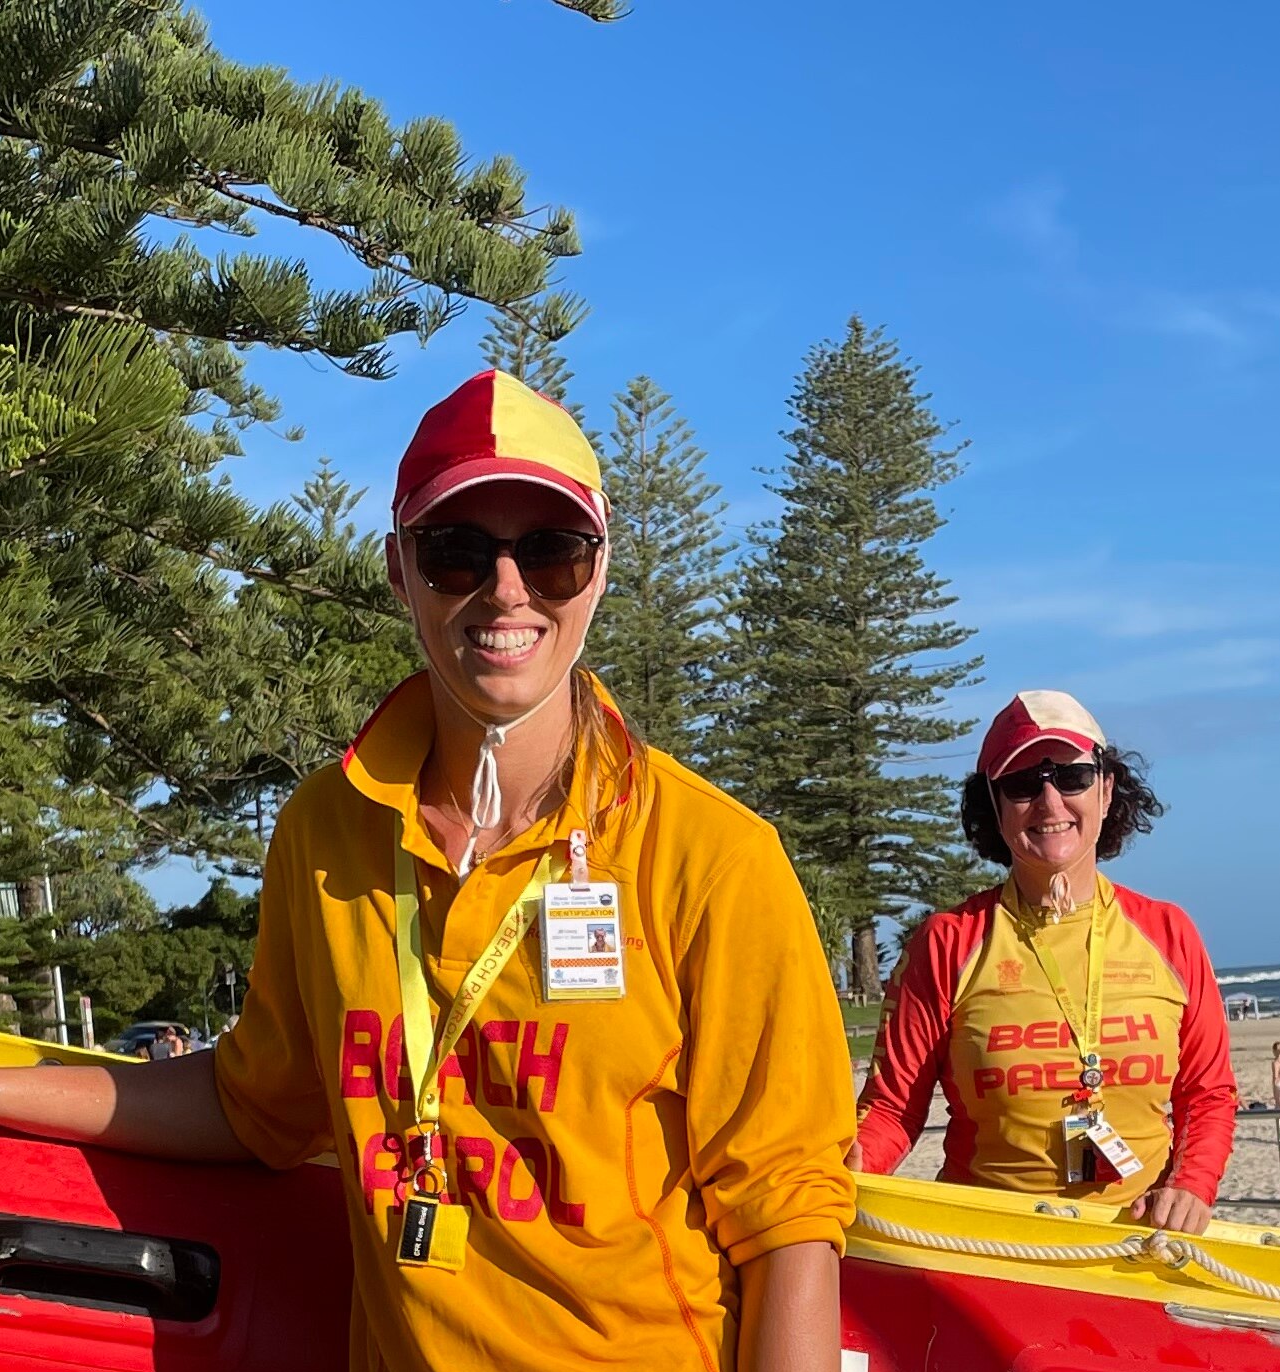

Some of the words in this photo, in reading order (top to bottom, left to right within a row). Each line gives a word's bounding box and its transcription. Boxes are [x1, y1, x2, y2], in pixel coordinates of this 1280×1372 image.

[550, 909, 615, 918] IDENTIFICATION
[475, 926, 518, 981] BEACH
[444, 980, 482, 1041] PATROL
